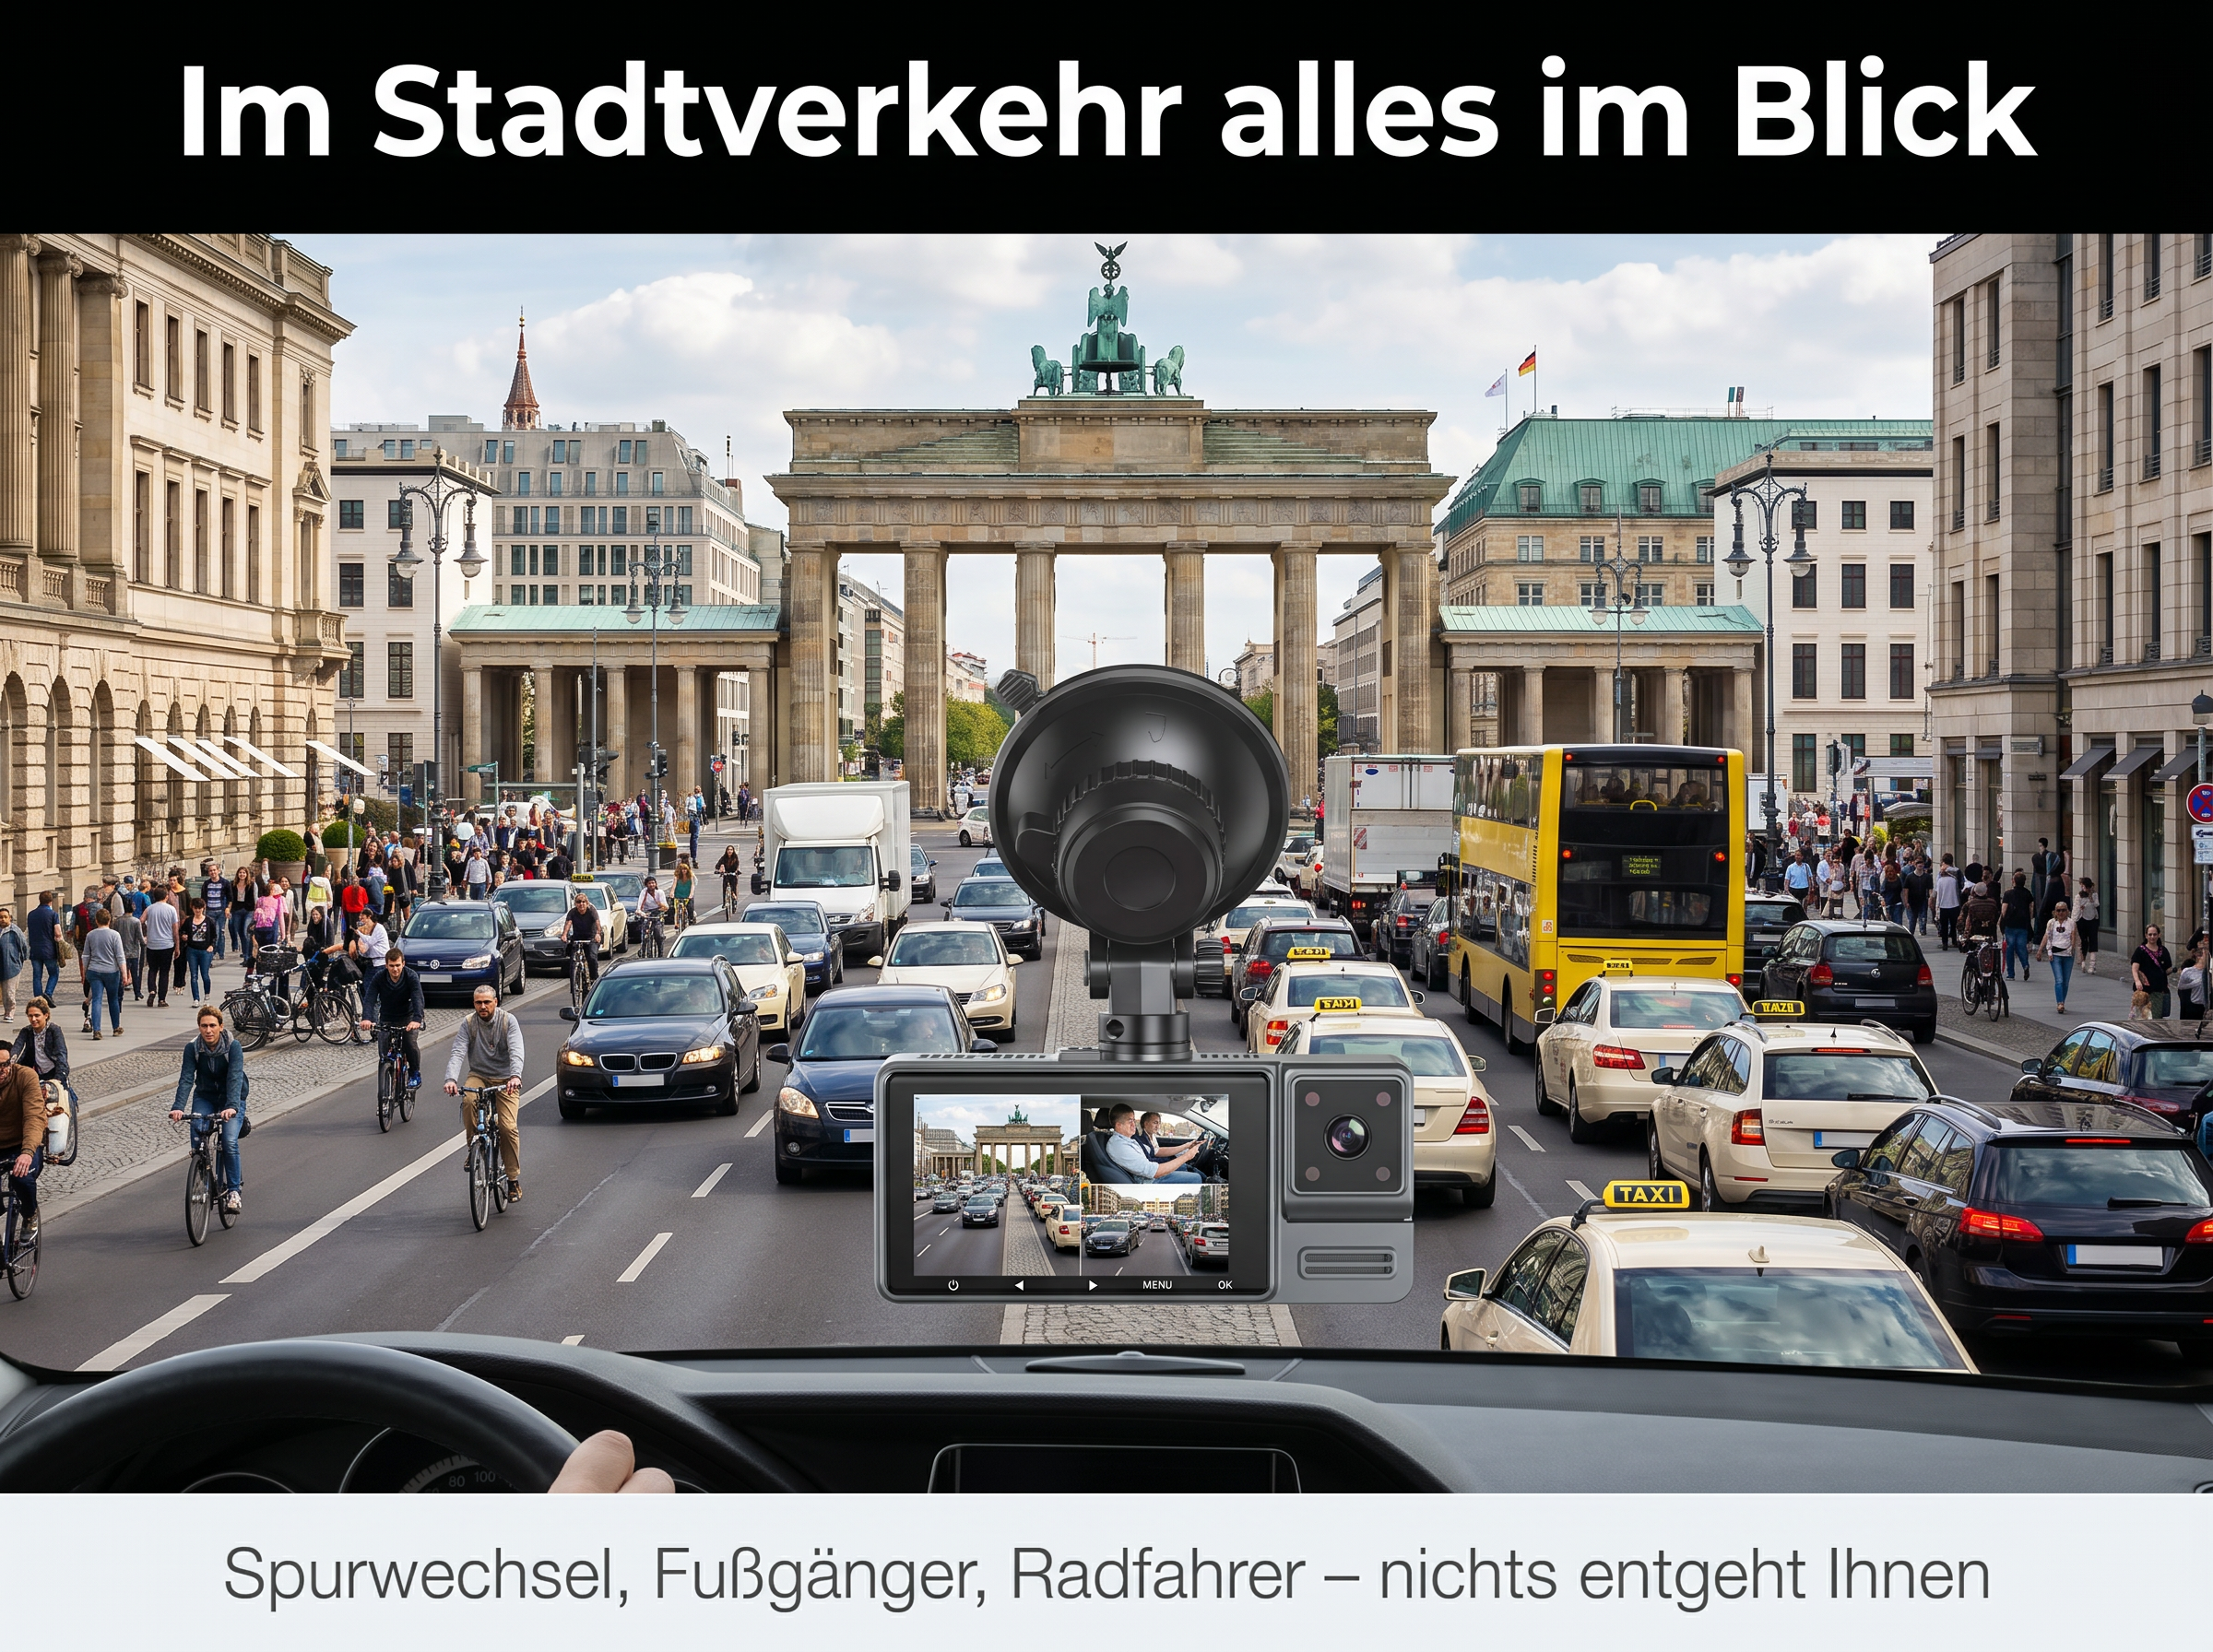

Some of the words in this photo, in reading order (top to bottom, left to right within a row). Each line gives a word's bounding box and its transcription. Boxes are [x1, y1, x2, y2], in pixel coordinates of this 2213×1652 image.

[1619, 1186, 1675, 1202] TAXI
[1142, 1280, 1173, 1290] MENU
[1217, 1280, 1233, 1290] OK
[448, 1475, 466, 1487] 80
[474, 1470, 496, 1482] 100
